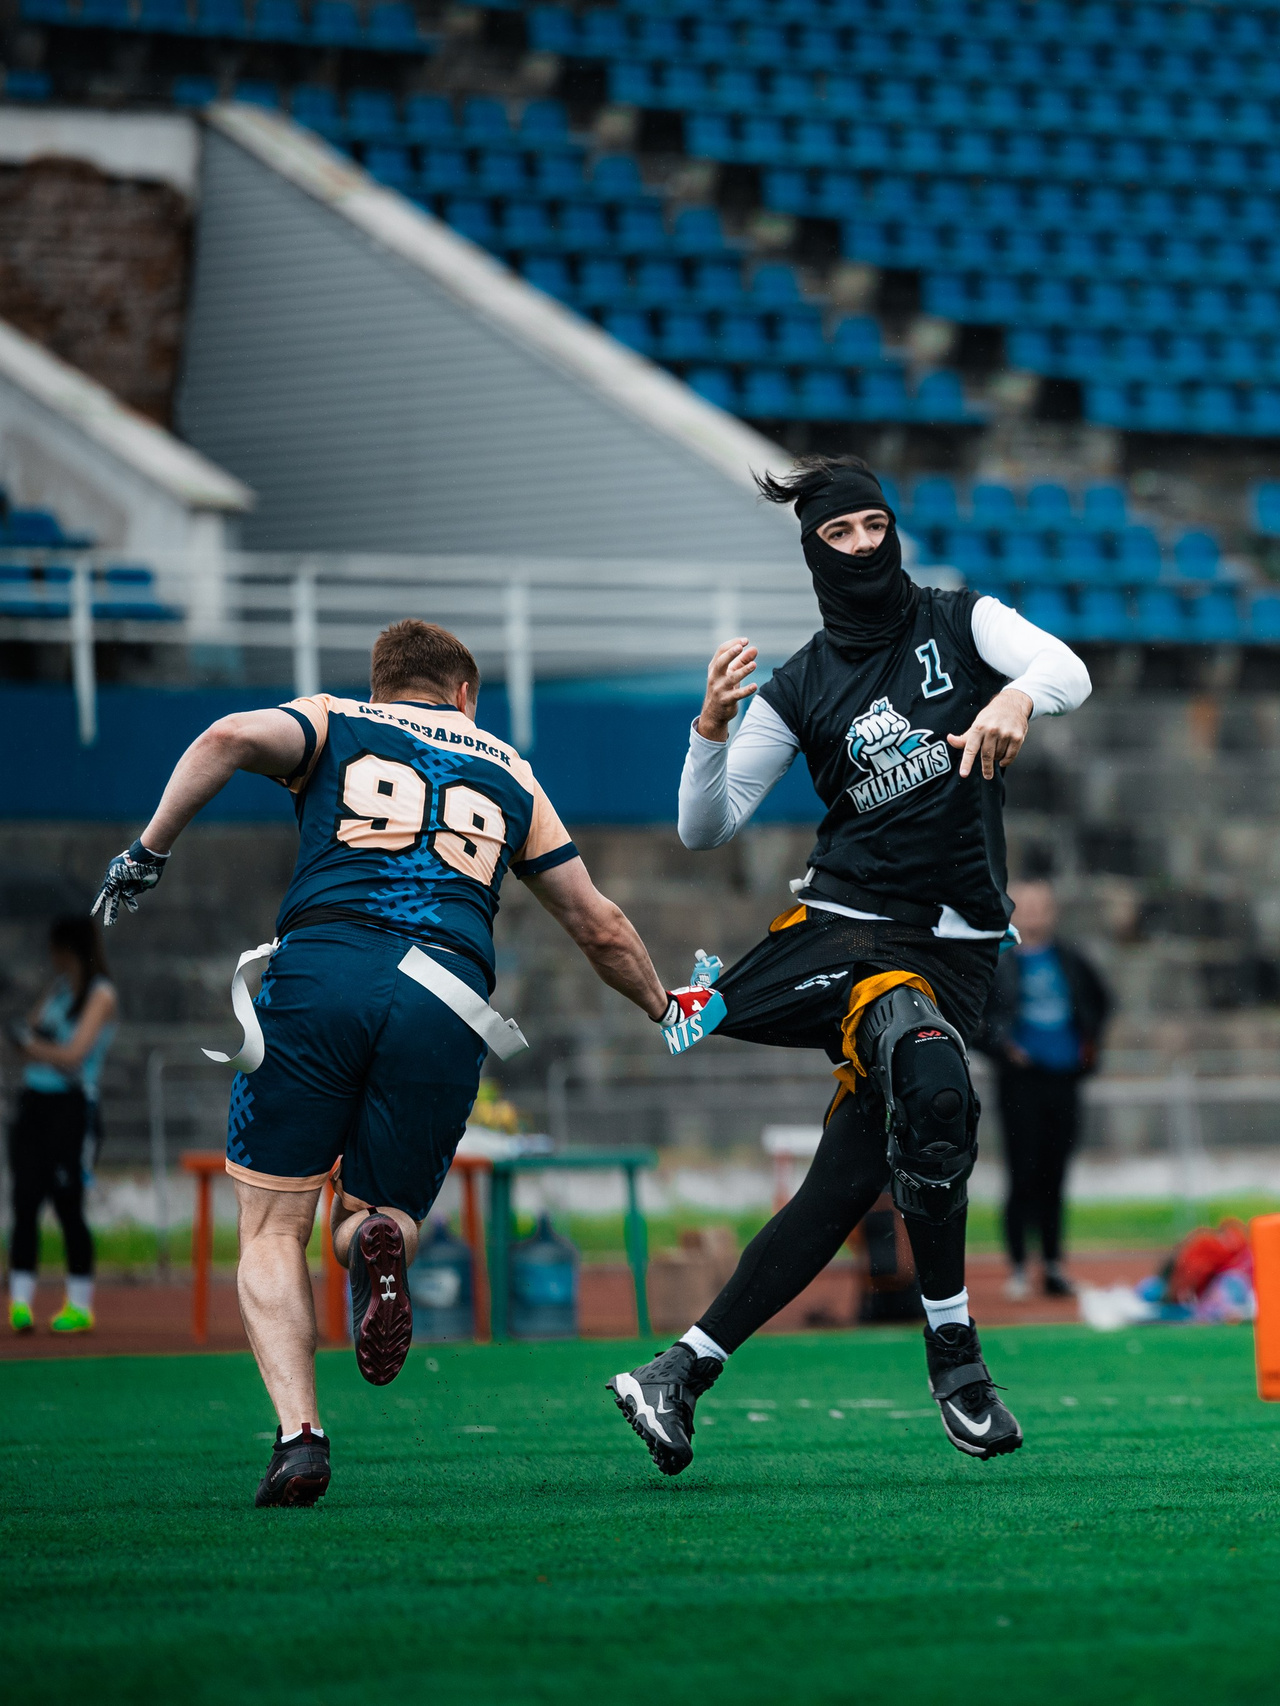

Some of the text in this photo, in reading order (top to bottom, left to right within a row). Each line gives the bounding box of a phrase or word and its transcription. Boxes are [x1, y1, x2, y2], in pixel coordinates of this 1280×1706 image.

[915, 639, 953, 698] 1
[851, 745, 949, 811] MUTANTS
[335, 752, 507, 887] 99
